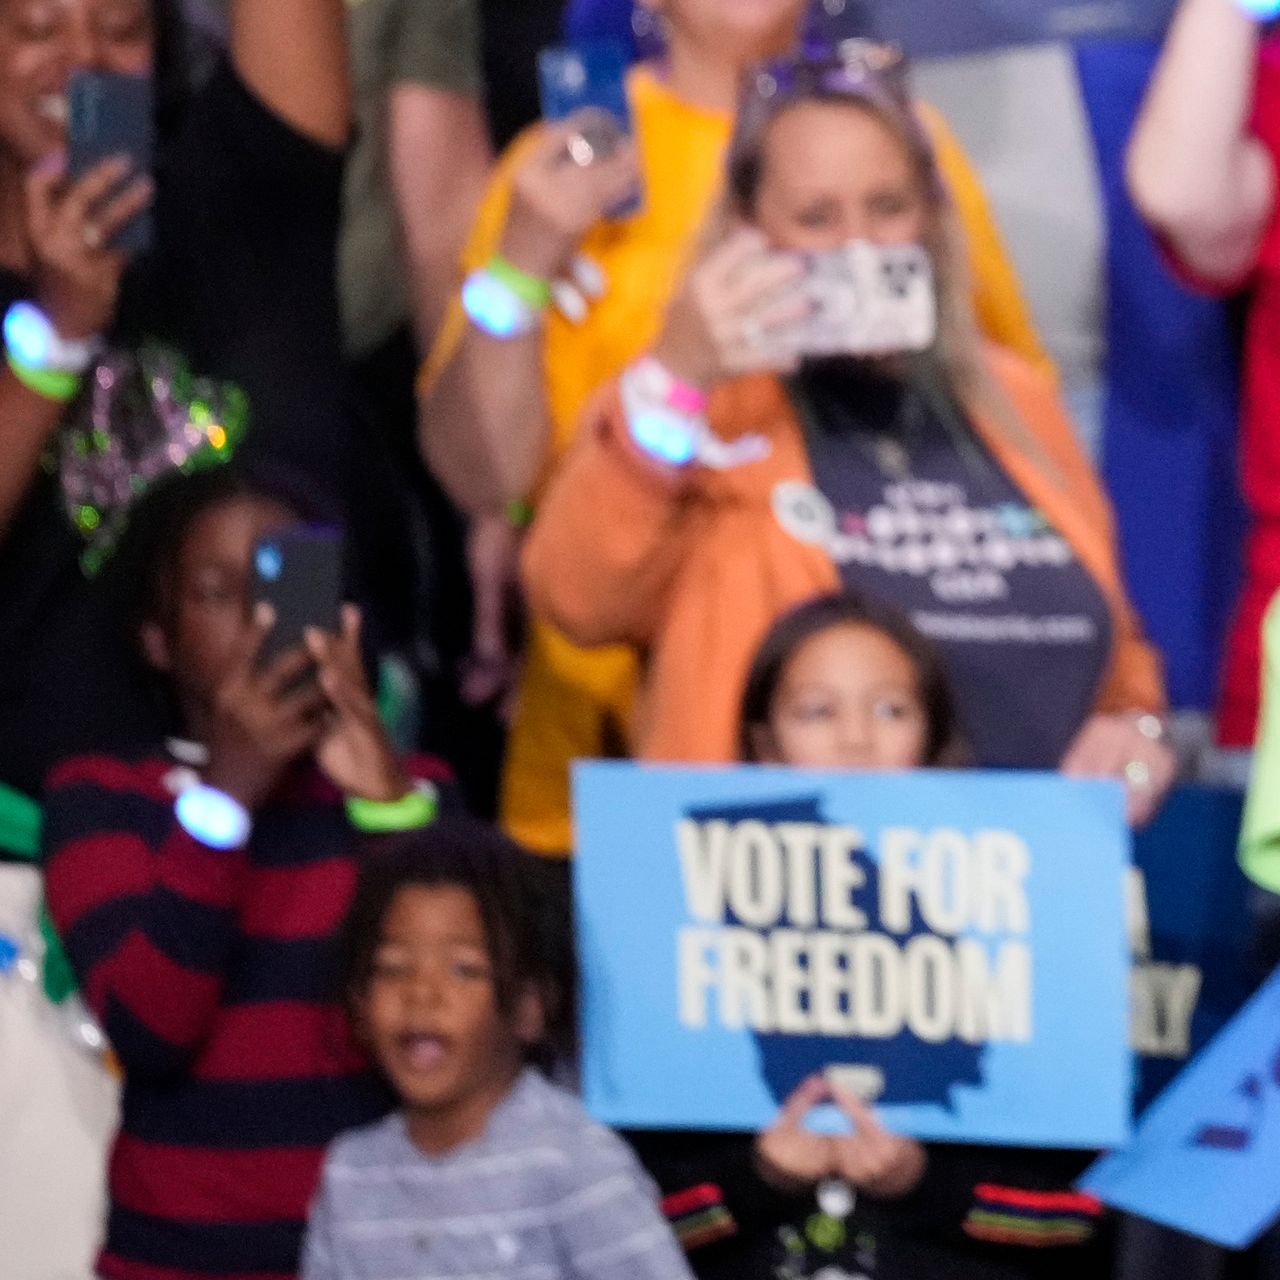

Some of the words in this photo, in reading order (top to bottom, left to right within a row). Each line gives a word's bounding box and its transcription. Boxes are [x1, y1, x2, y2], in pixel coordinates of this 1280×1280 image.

[677, 818, 868, 934] VOTE
[878, 825, 1030, 936] FOR
[677, 925, 1034, 1045] FREEDOM
